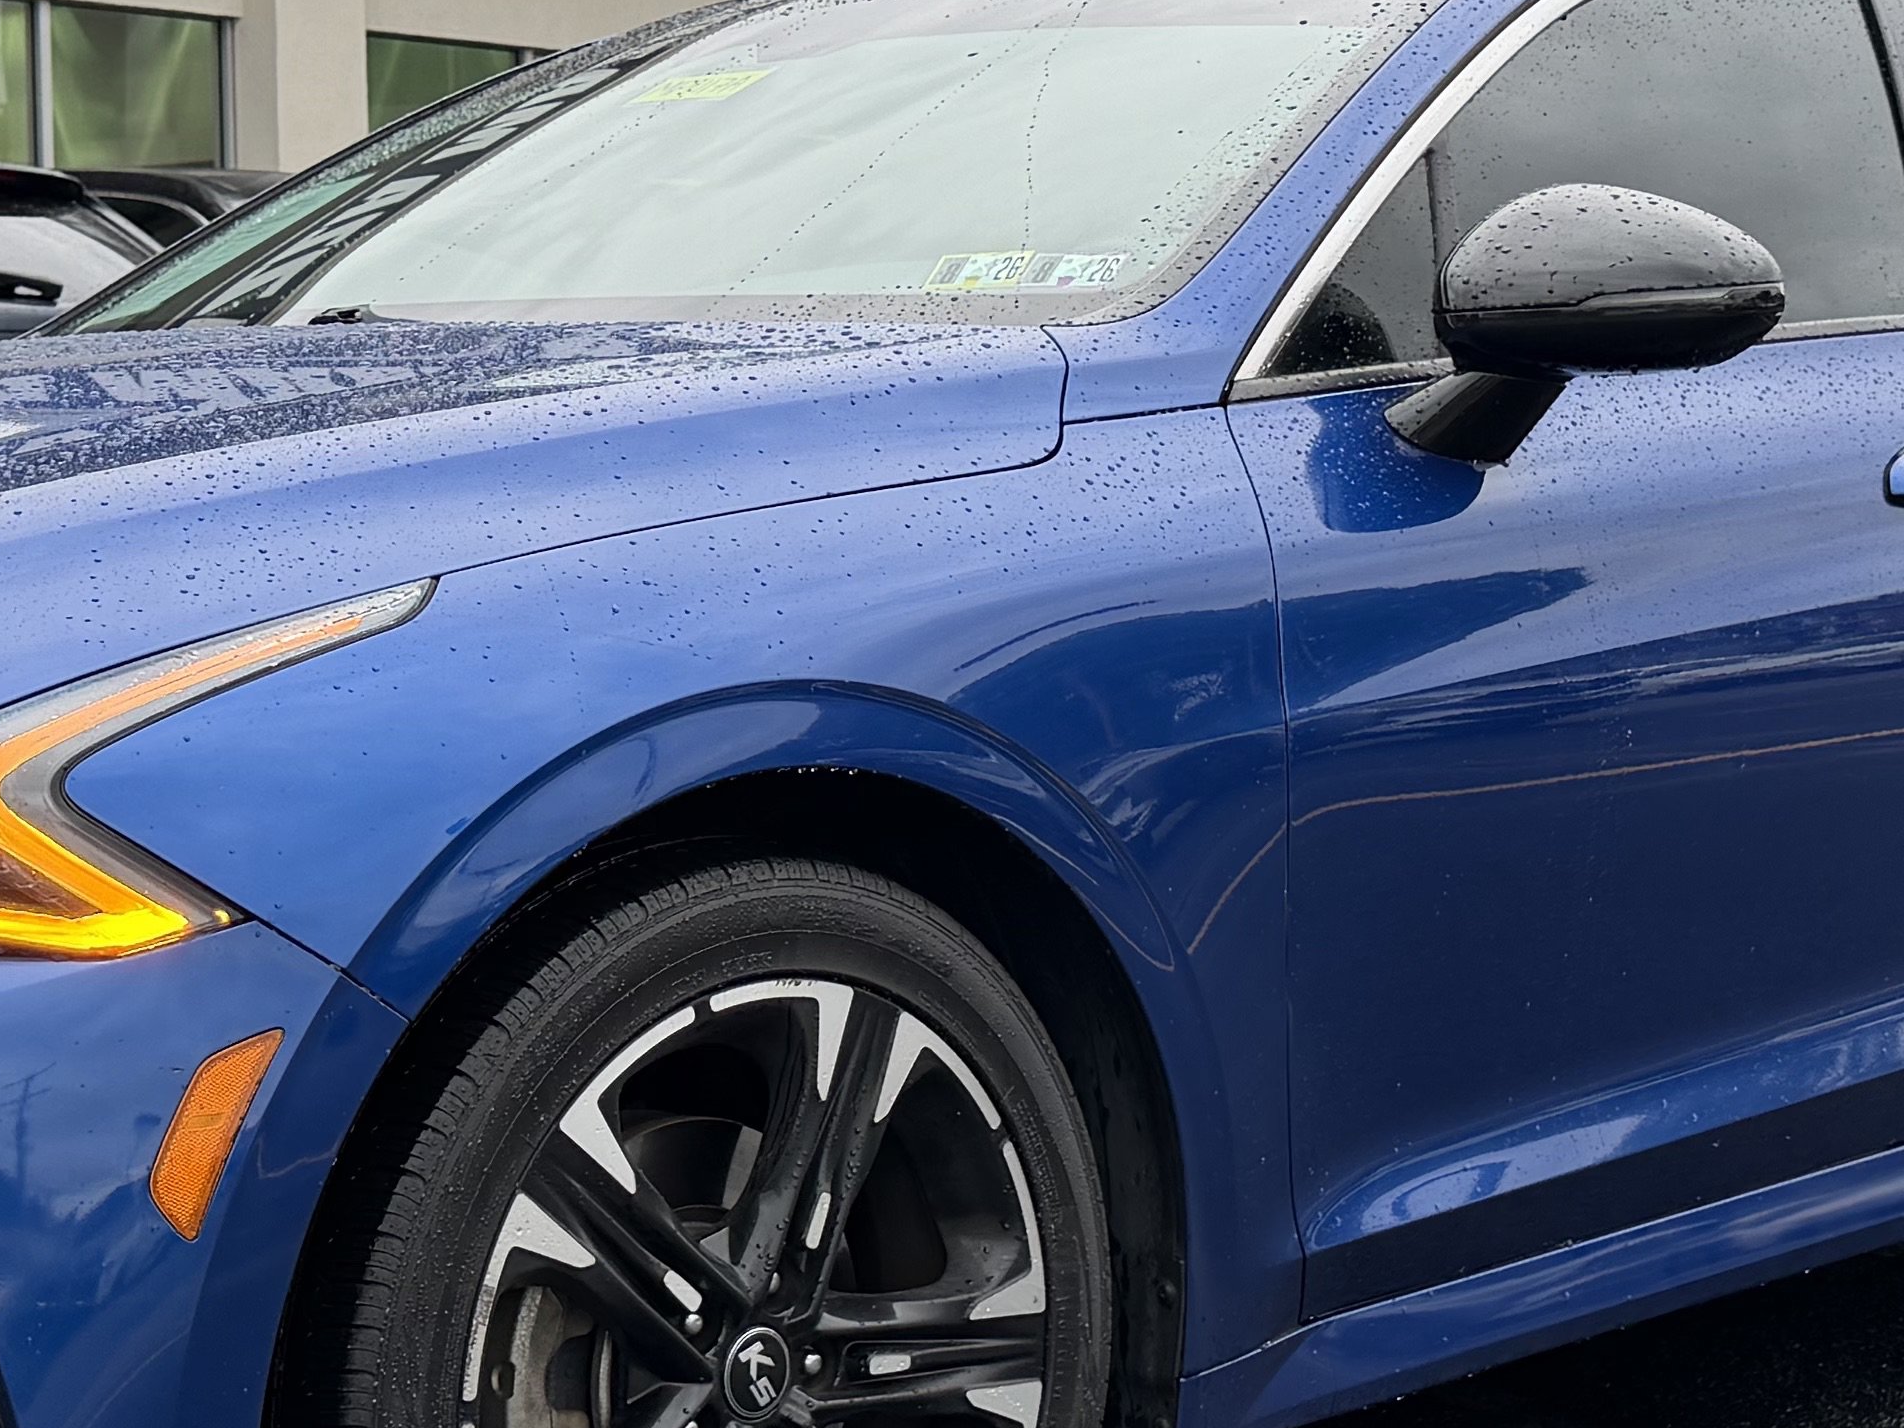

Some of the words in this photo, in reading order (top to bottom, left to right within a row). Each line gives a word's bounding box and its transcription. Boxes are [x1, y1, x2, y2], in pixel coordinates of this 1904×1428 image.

[993, 256, 1025, 280] 26
[1087, 258, 1120, 283] 26
[737, 1340, 777, 1408] K5
